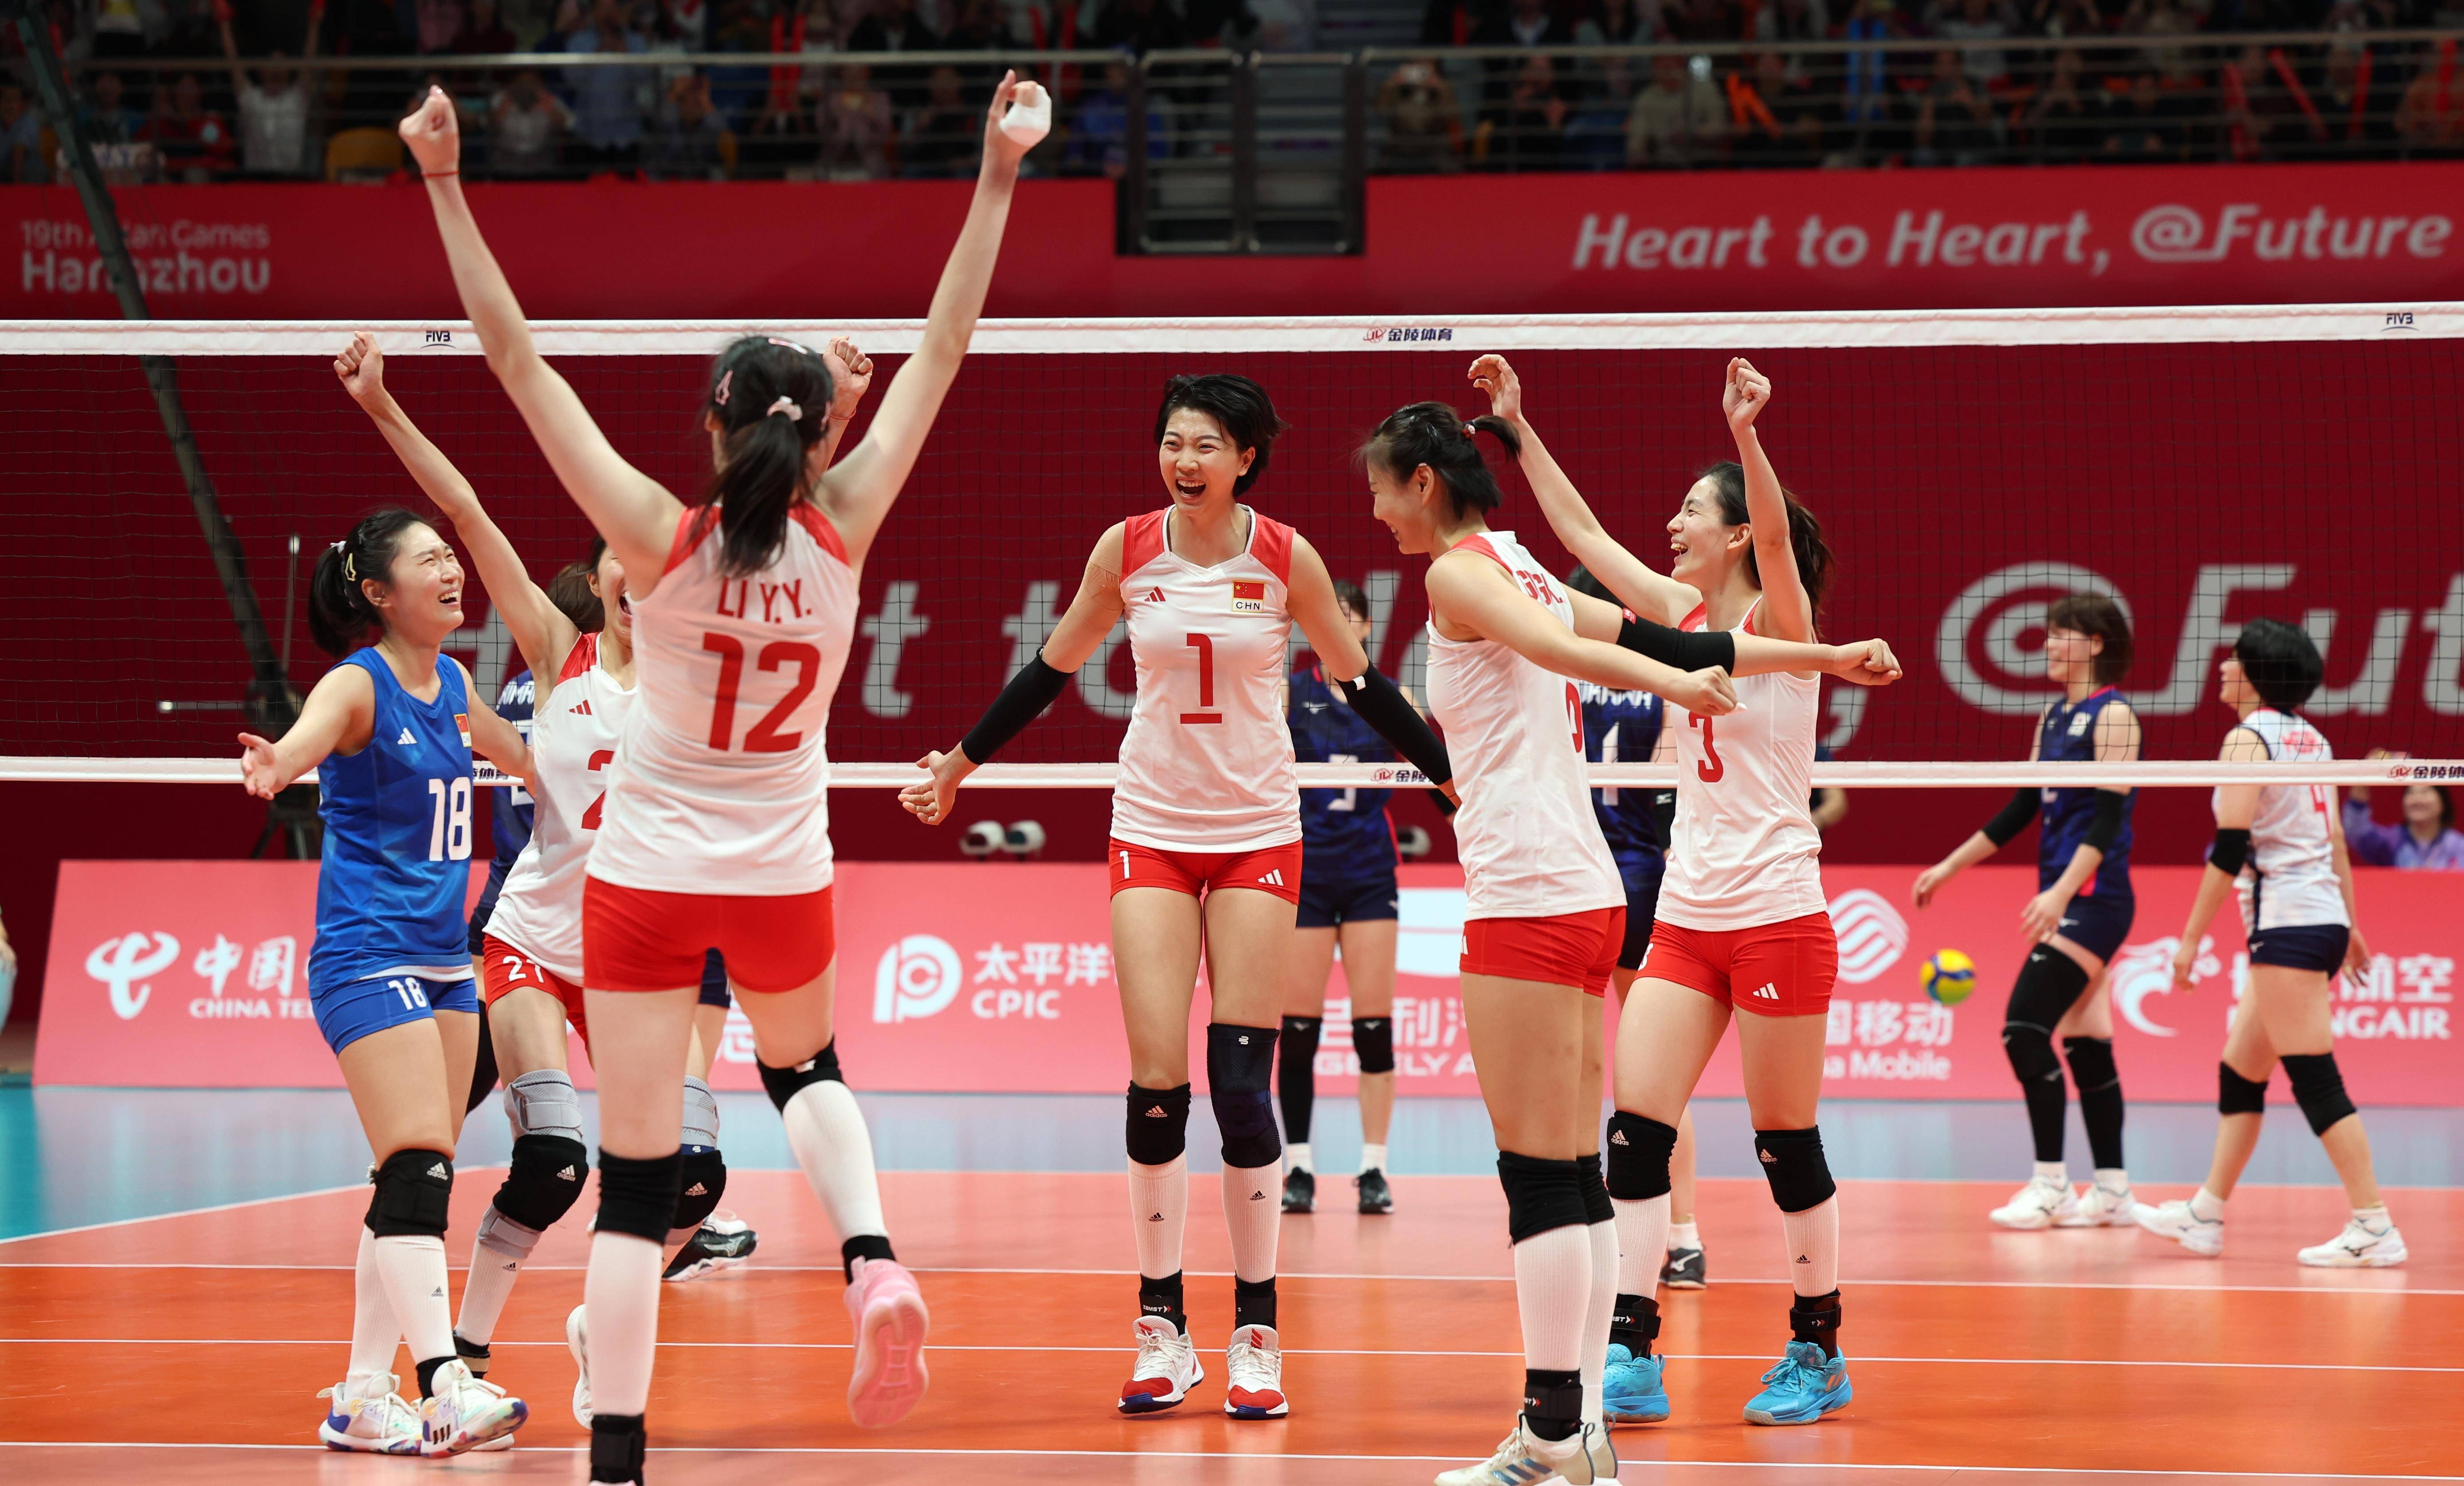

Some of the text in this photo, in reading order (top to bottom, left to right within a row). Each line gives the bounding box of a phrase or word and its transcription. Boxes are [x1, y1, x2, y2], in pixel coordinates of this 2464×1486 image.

[21, 220, 270, 249] 19th ian Games
[1573, 204, 2452, 277] Heart to Heart, @Future
[23, 250, 271, 294] Hanzhou
[426, 330, 451, 342] FIVB
[1388, 328, 1453, 341] 金陵体育
[717, 577, 748, 620] LI
[1236, 601, 1261, 610] CHN
[1187, 633, 1213, 707] 1
[702, 632, 821, 752] 12
[1688, 712, 1724, 783] 3
[473, 767, 509, 780] 体育
[1396, 770, 1432, 782] 金陵
[428, 777, 472, 861] 18
[1119, 850, 1130, 879] 1
[193, 933, 312, 998] 中国
[973, 942, 1118, 987] 太平洋
[189, 998, 271, 1019] CHINA
[388, 977, 428, 1010] 18
[971, 989, 1060, 1019] CPIC
[1611, 1137, 1629, 1146] adidas
